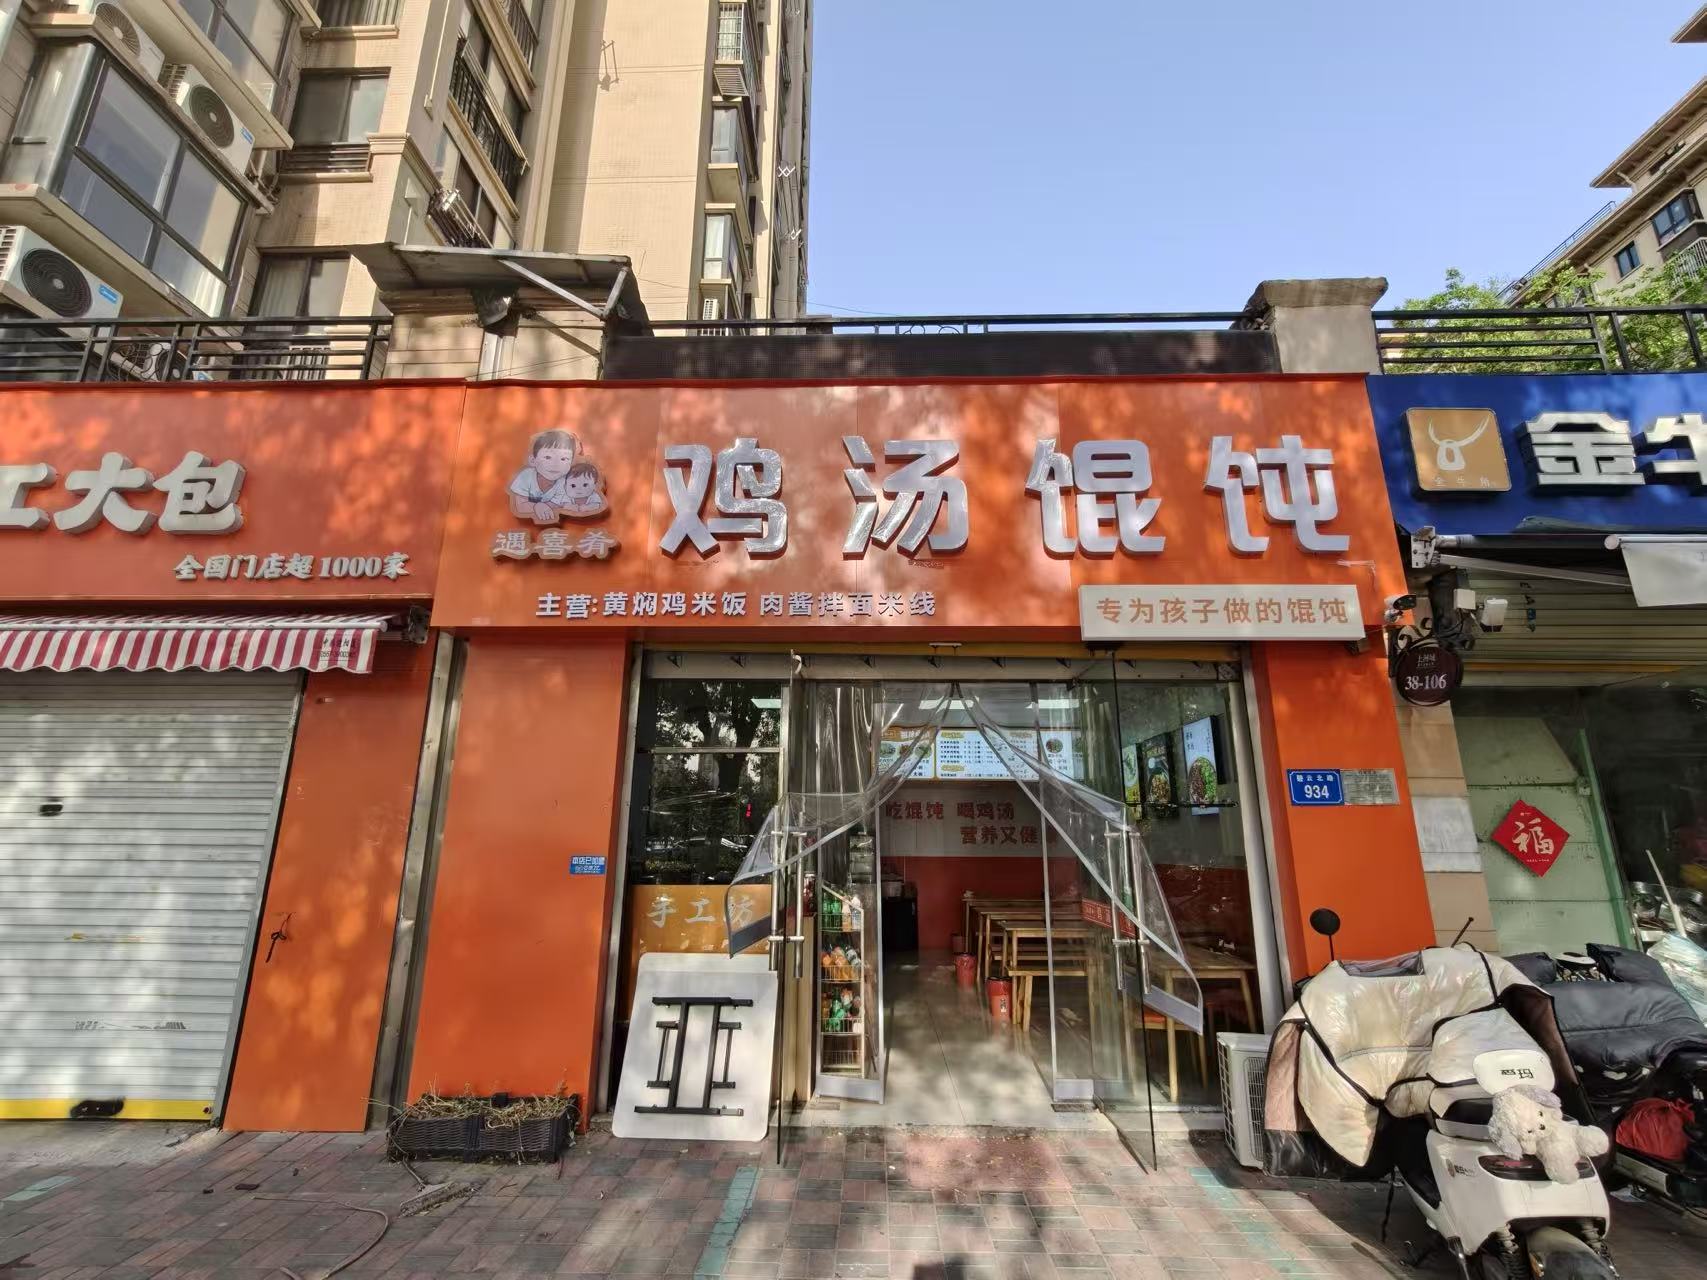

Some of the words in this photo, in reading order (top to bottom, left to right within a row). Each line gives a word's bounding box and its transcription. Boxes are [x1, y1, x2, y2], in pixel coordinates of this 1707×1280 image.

[659, 434, 1350, 559] 鸡汤馄饨
[493, 529, 618, 559] 遇喜肴
[760, 591, 937, 619] 肉酱拌面米线
[1096, 597, 1349, 625] 专为孩子做的馄饨
[1404, 673, 1448, 691] 38-106
[1304, 785, 1330, 799] 934
[885, 801, 944, 820] 吃馄饨
[957, 801, 1015, 820] 喝鸡汤
[1511, 817, 1555, 855] 福
